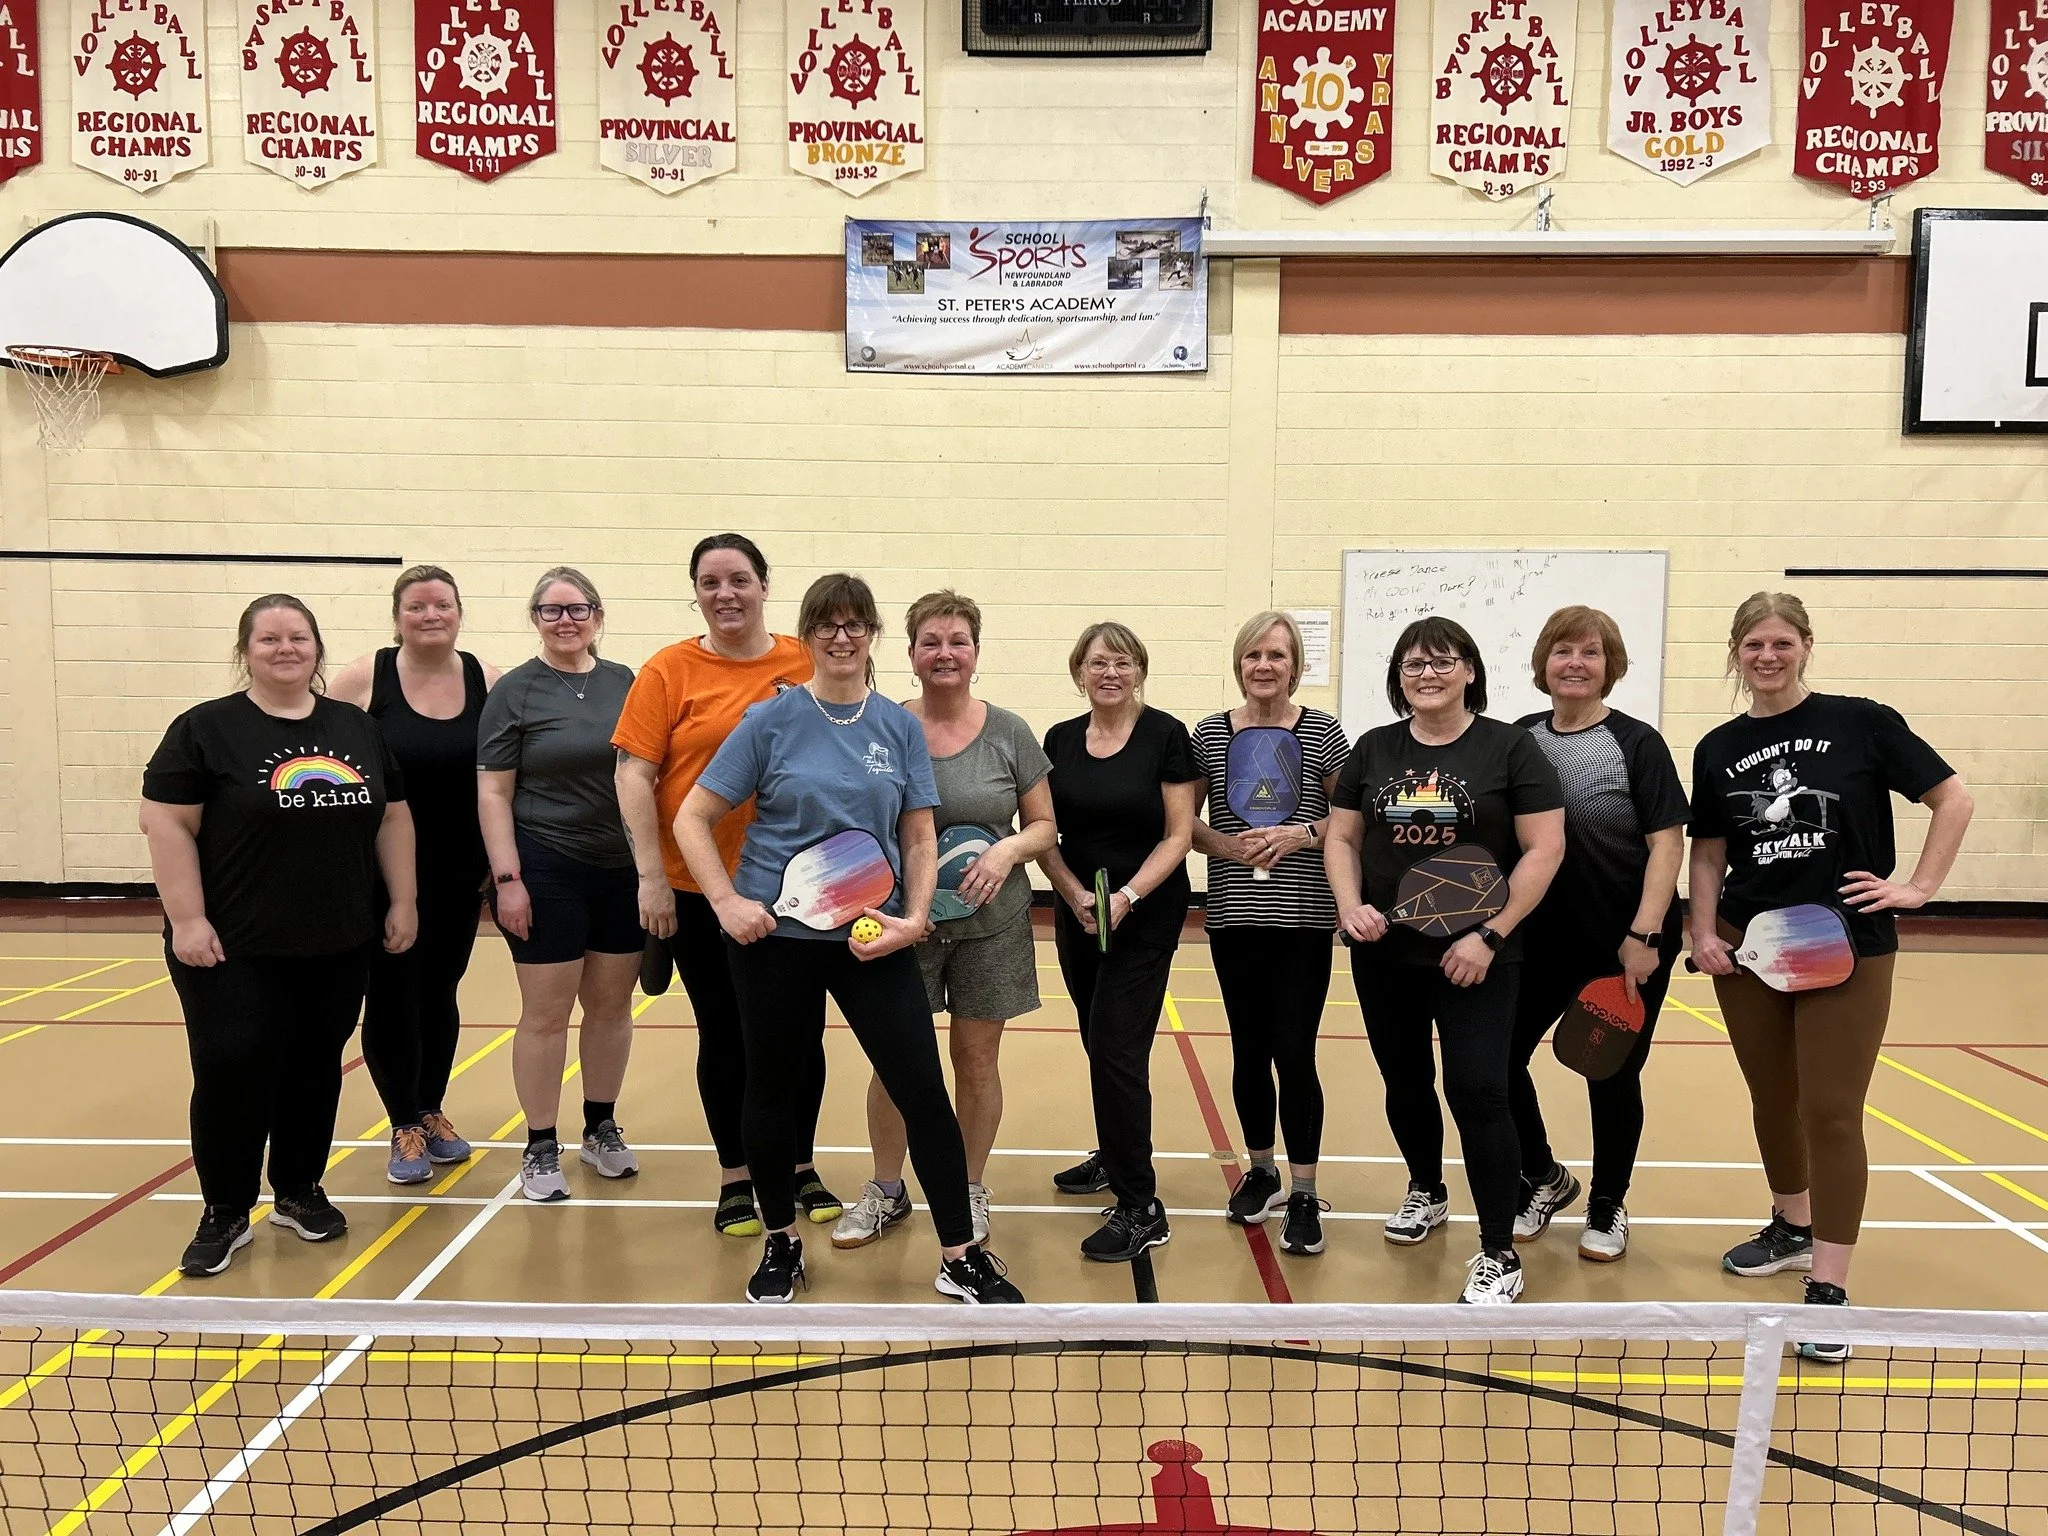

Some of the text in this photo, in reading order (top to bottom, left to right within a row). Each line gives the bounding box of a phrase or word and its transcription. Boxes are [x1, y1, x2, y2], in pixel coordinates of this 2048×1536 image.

[1262, 8, 1387, 32] ACADEMY
[242, 0, 372, 82] BASKBALL
[1435, 0, 1568, 106] BASKETBALL
[1623, 0, 1757, 97] VOLLEYBALL
[1803, 2, 1939, 103] VOLLEYBALL
[78, 111, 202, 134] REGIONAL
[247, 111, 375, 136] REGIONAL
[417, 101, 554, 127] REGIONAL
[1626, 105, 1743, 134] JR. BOYS
[600, 119, 736, 141] PROVINCIAL
[789, 120, 923, 144] PROVINCIAL
[1437, 123, 1566, 149] REGIONAL
[1806, 125, 1933, 153] REGIONAL
[91, 136, 191, 157] CHAMPS
[261, 136, 362, 161] CHAMPS
[430, 132, 539, 157] CHAMPS
[624, 142, 712, 168] SILVER
[807, 144, 905, 165] BRONZE
[1644, 132, 1725, 158] GOLD
[2011, 140, 2048, 161] SIL
[468, 158, 500, 173] 1991
[835, 165, 878, 180] 1991-92
[1449, 149, 1550, 175] CHAMPS
[1659, 158, 1695, 172] 1992
[1815, 152, 1919, 178] CHAMPS
[124, 168, 158, 182] 90-91
[650, 167, 685, 182] 90-91
[1005, 233, 1059, 244] SCHOOL
[938, 297, 1117, 311] ST. PETER'S ACADEMY
[940, 315, 970, 324] success
[972, 315, 1006, 325] through
[1007, 314, 1054, 324] dedication,
[1056, 312, 1118, 325] sportsmanship,
[1121, 313, 1138, 321] and
[1726, 738, 1831, 779] I COULDN'T DO IT
[276, 787, 372, 808] be kind
[1392, 824, 1456, 845] 2025
